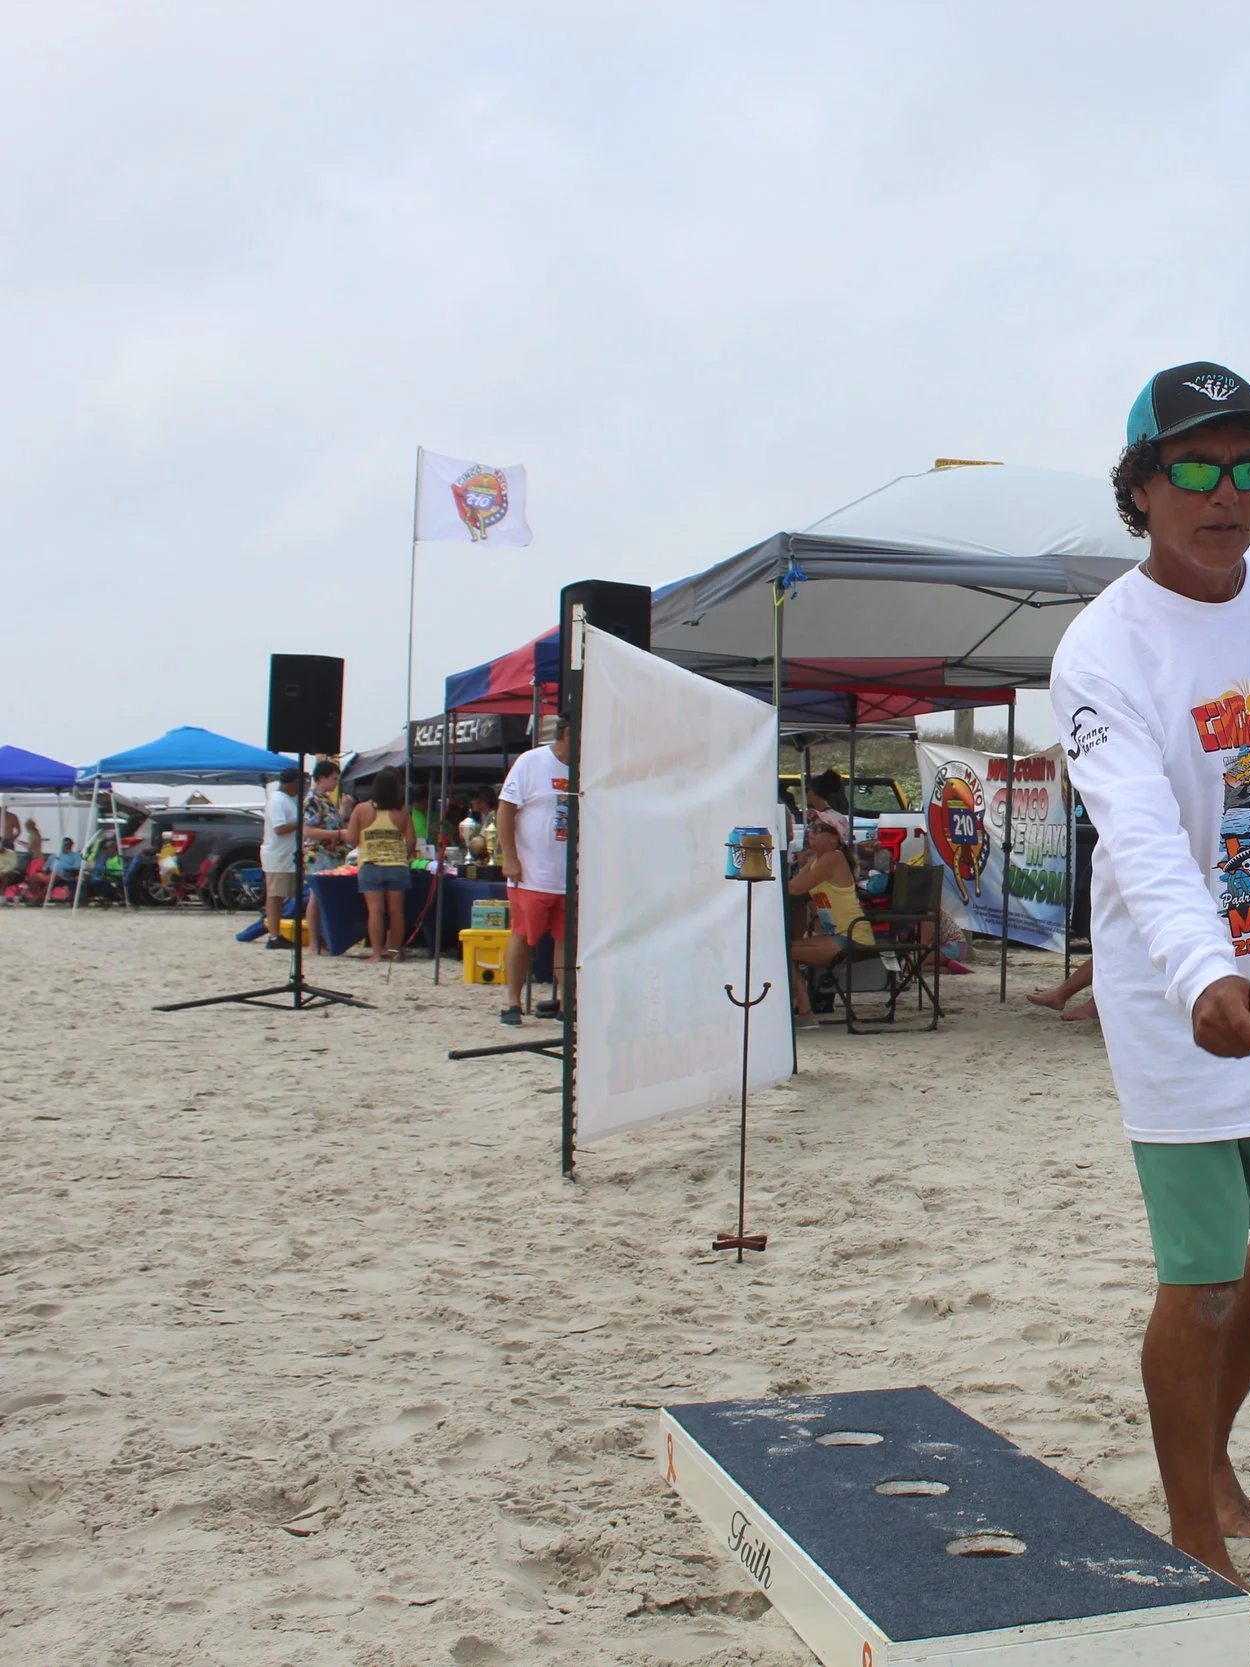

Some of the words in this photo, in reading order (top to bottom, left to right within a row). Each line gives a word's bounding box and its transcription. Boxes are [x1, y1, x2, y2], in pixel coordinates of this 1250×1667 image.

[466, 493, 490, 508] 210
[987, 757, 1047, 782] WECOME
[964, 768, 984, 806] MAYO
[953, 814, 974, 837] 210
[728, 1510, 772, 1590] Faith
